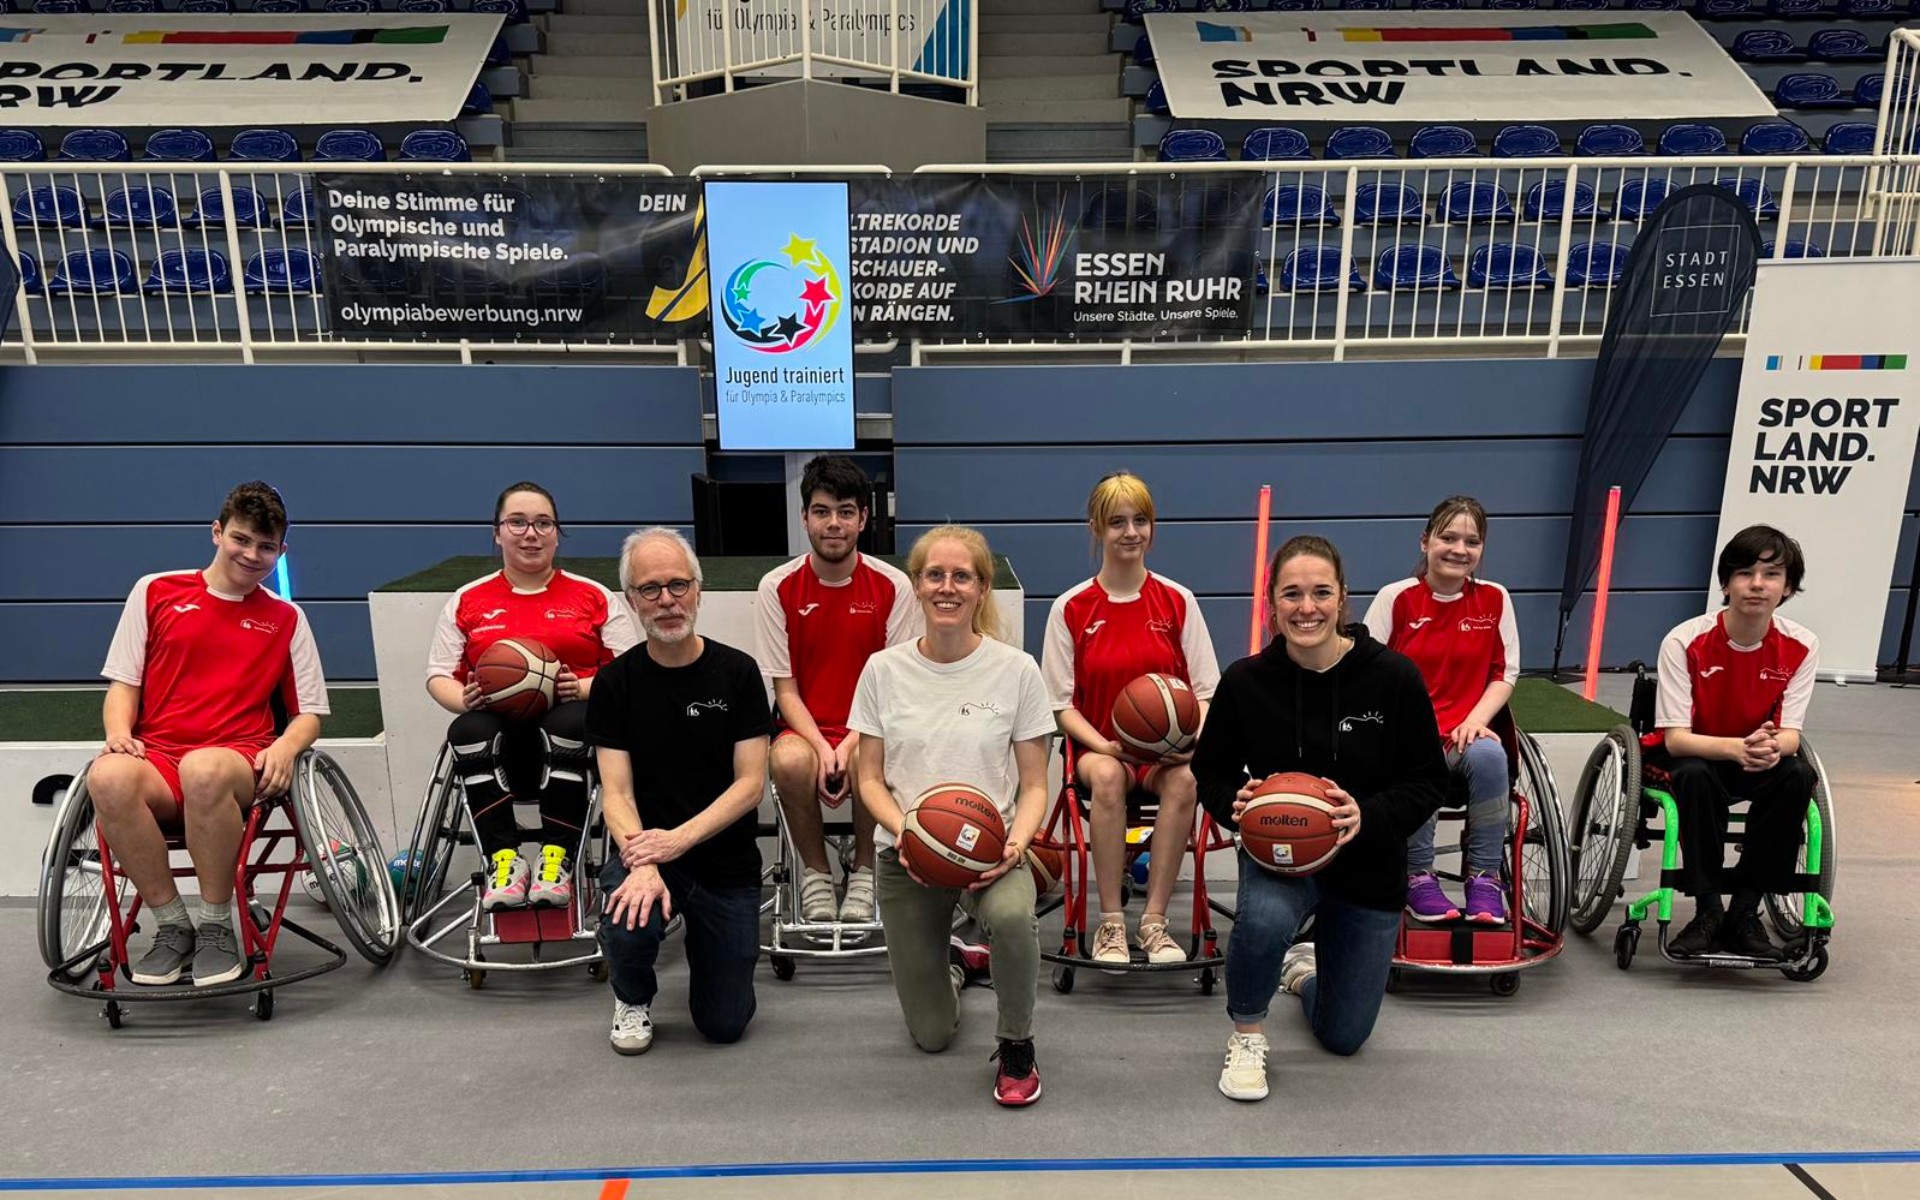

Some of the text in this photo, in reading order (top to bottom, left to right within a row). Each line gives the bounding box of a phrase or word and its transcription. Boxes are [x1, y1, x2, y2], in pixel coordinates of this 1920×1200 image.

[734, 7, 797, 36] Olympia
[822, 8, 915, 36] Paralympcs
[1220, 81, 1405, 107] NRW
[328, 190, 515, 213] Deine Stimme für
[639, 194, 686, 212] DEIN
[331, 215, 505, 237] Olympische und
[334, 239, 568, 264] Paralympische Spiele.
[936, 237, 979, 255] UND
[1075, 253, 1165, 276] ESSEN
[1665, 251, 1728, 268] STADT
[917, 282, 956, 299] AUF
[1074, 277, 1242, 304] RHEIN RUHR
[1663, 272, 1725, 289] ESSEN
[341, 303, 583, 326] olympiabewerbung.nrw
[870, 301, 955, 322] RÄNGEN.
[1073, 307, 1238, 322] Unsere Städte. Unsere Spiele.
[725, 366, 844, 387] Jugend trainiert
[726, 390, 845, 406] für Olympia & Paralympics
[1757, 398, 1900, 428] SPORT
[1754, 432, 1875, 461] LAND.
[1749, 465, 1852, 494] NRW
[955, 797, 997, 823] molten
[1260, 814, 1308, 827] molten
